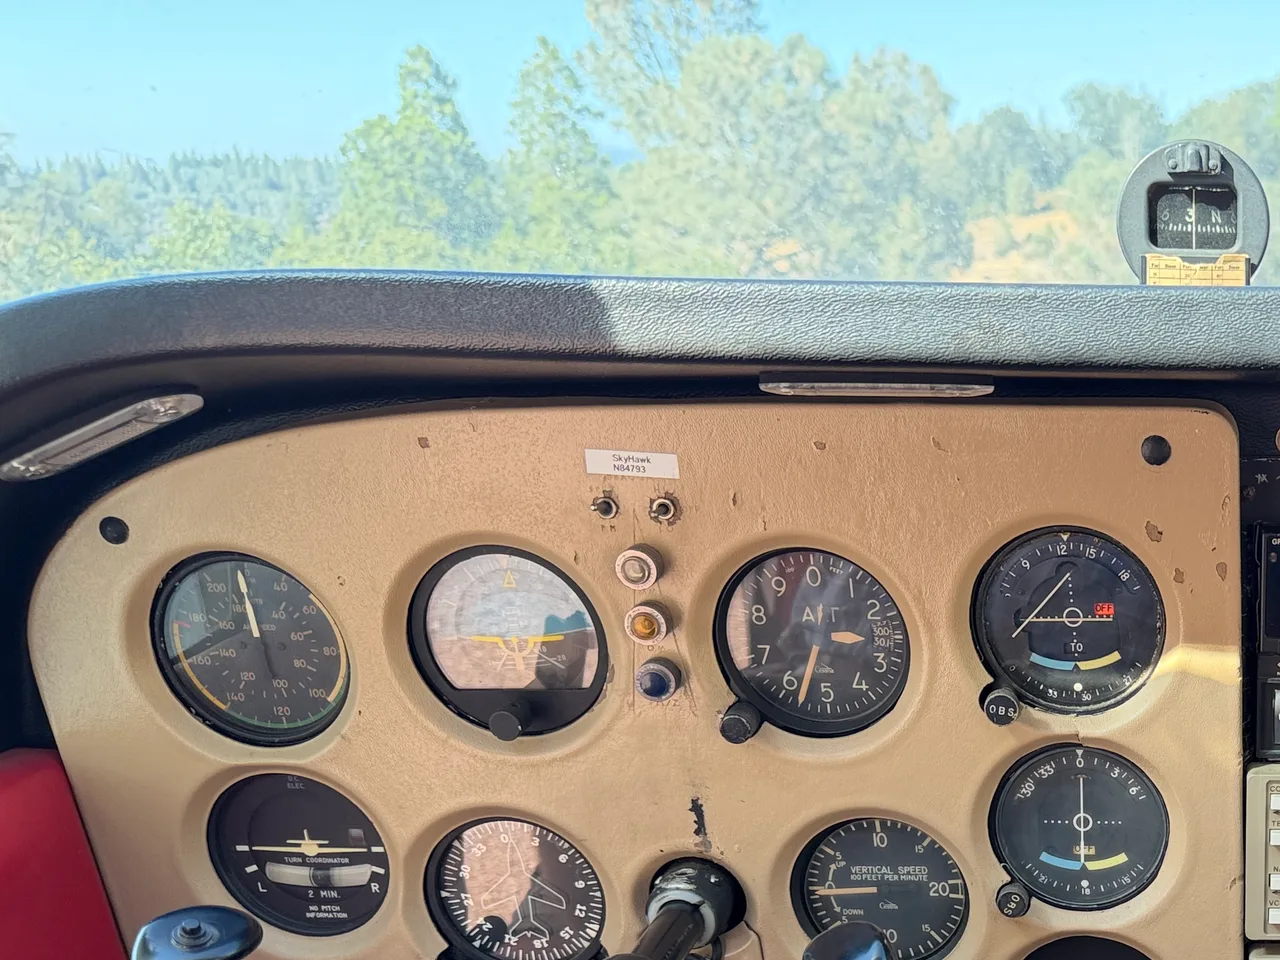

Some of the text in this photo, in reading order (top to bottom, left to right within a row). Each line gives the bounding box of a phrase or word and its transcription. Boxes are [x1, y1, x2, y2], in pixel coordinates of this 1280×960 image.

[612, 454, 651, 464] SkyHawk
[614, 464, 646, 473] N84793
[207, 583, 226, 593] 200
[274, 582, 288, 592] 40
[771, 576, 787, 597] 9
[303, 606, 317, 615] 60
[867, 600, 881, 620] 2
[1095, 604, 1113, 613] OFF
[272, 610, 286, 620] 40
[752, 605, 767, 625] 8
[290, 632, 304, 641] 60
[323, 647, 337, 656] 80
[1070, 643, 1083, 652] TO
[220, 649, 236, 658] 140
[757, 645, 771, 665] 7
[293, 659, 306, 668] 80
[873, 653, 887, 673] 3
[240, 672, 255, 681] 120
[782, 670, 798, 690] 6
[852, 672, 869, 691] 4
[273, 680, 288, 688] 100
[227, 692, 245, 702] 140
[309, 689, 326, 698] 100
[821, 683, 834, 702] 5
[273, 707, 291, 716] 120
[989, 704, 1015, 717] OBS
[873, 832, 888, 848] 10
[850, 866, 928, 875] VERTICAL SPEED
[929, 882, 949, 897] 20
[843, 908, 864, 916] DOWN
